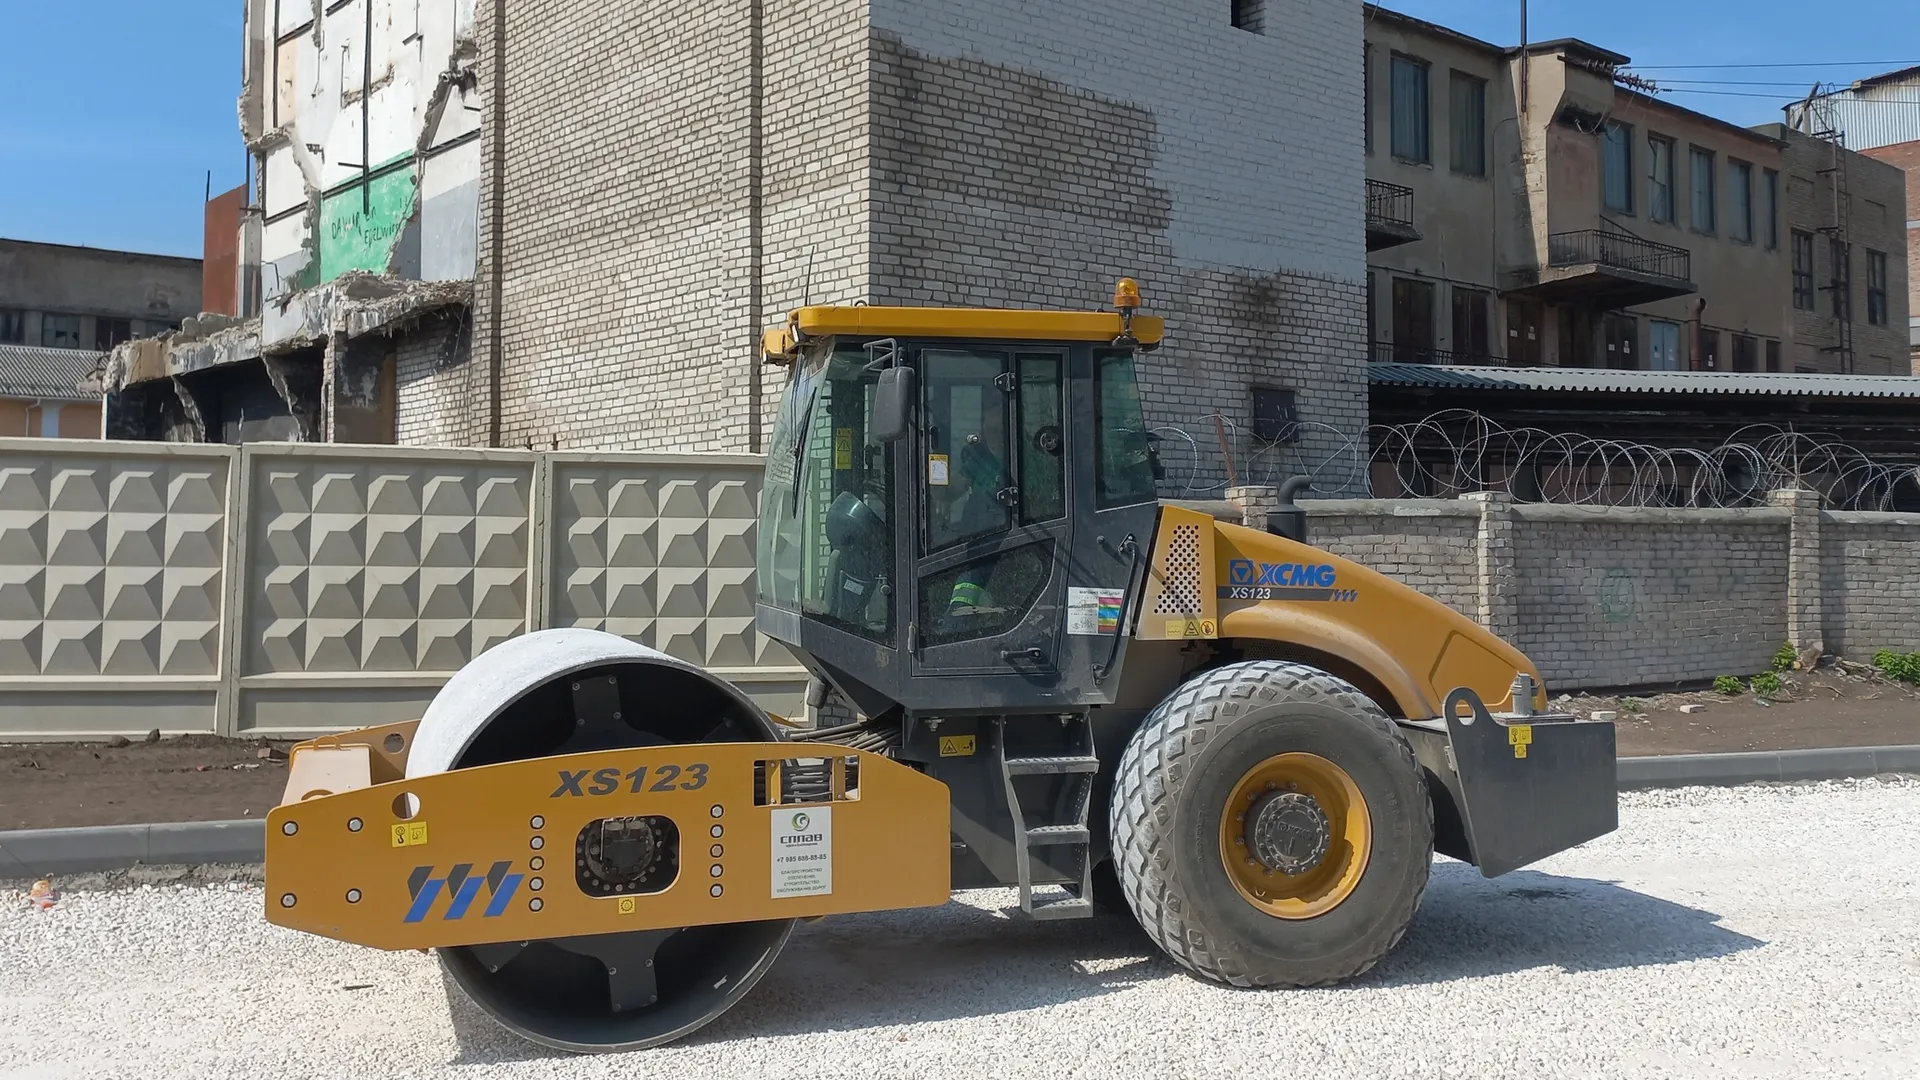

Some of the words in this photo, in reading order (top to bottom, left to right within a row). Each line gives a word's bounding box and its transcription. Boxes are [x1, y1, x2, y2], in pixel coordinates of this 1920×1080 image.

[1255, 563, 1336, 587] XCMG
[1230, 587, 1271, 599] XS123
[549, 763, 710, 799] XS123
